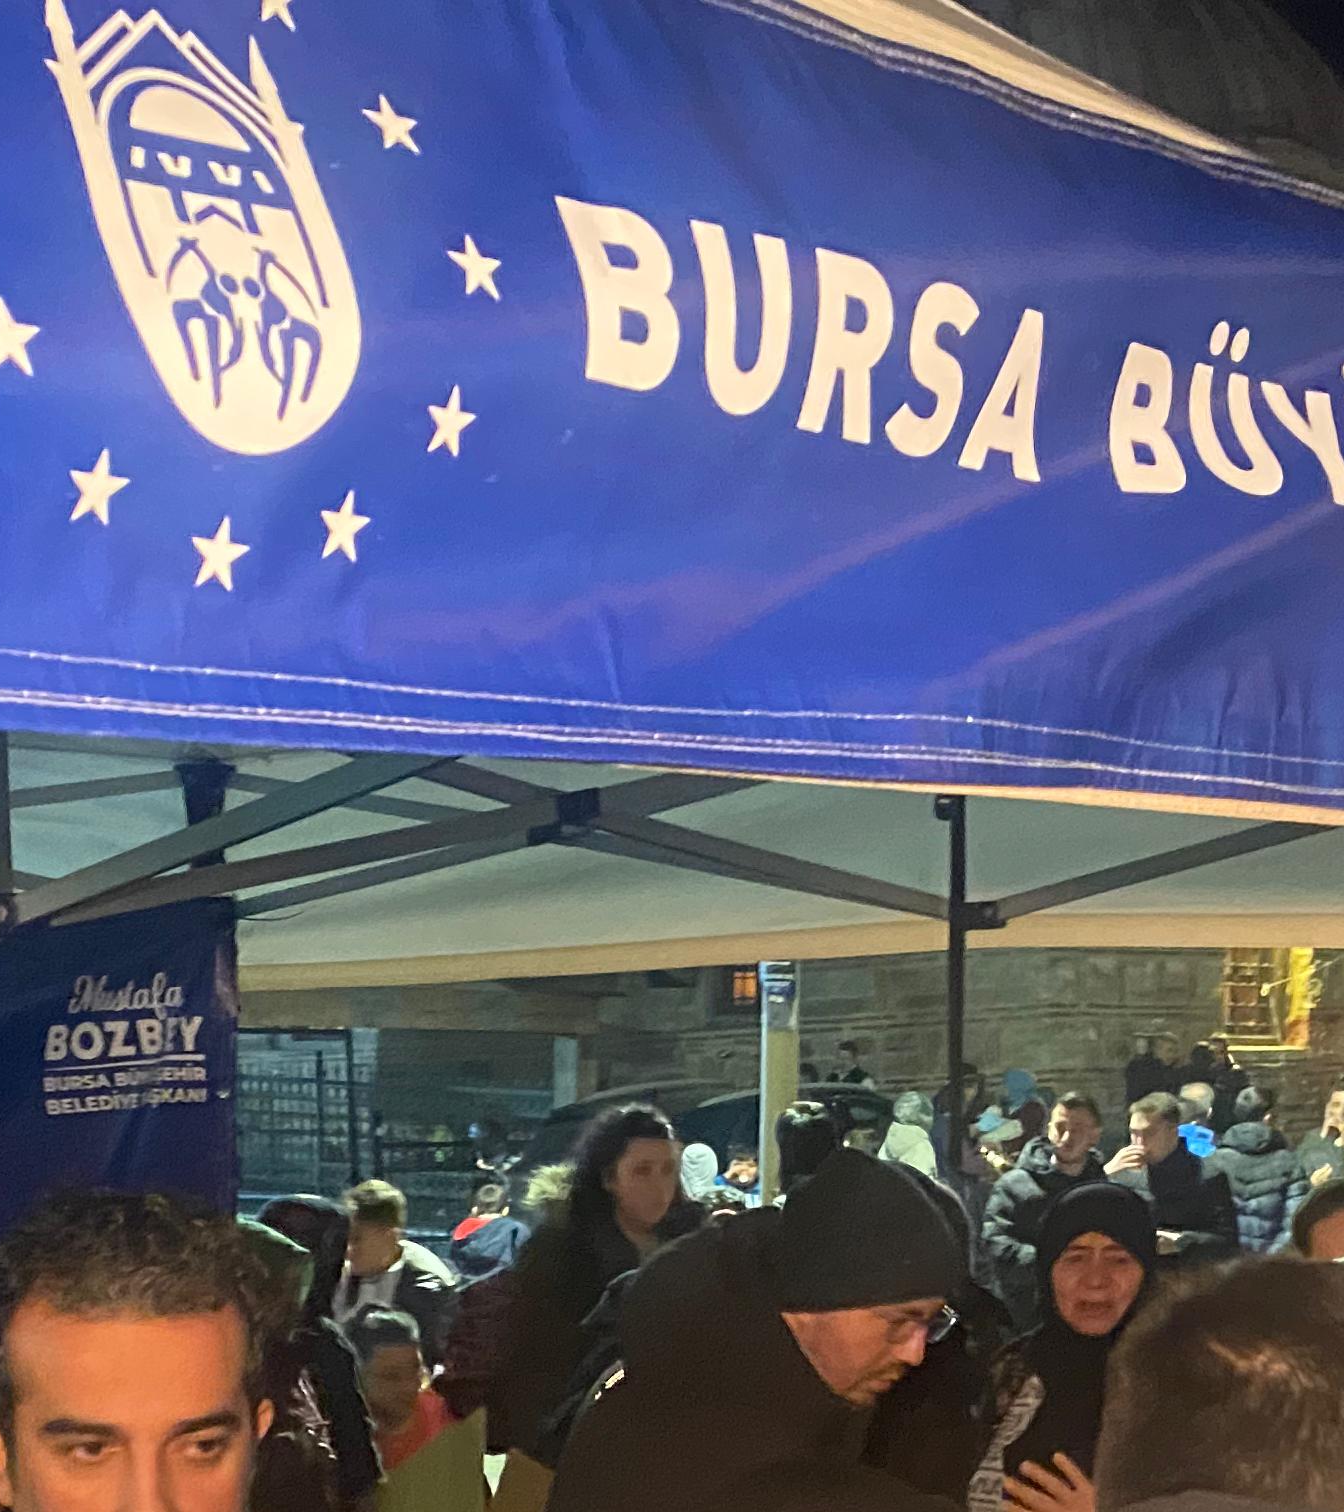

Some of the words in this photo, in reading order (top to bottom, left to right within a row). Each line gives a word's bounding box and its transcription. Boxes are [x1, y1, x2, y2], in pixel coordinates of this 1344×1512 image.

[553, 195, 1045, 483] BURSA
[67, 972, 184, 1020] Mustafa
[43, 1074, 111, 1093] BURSA
